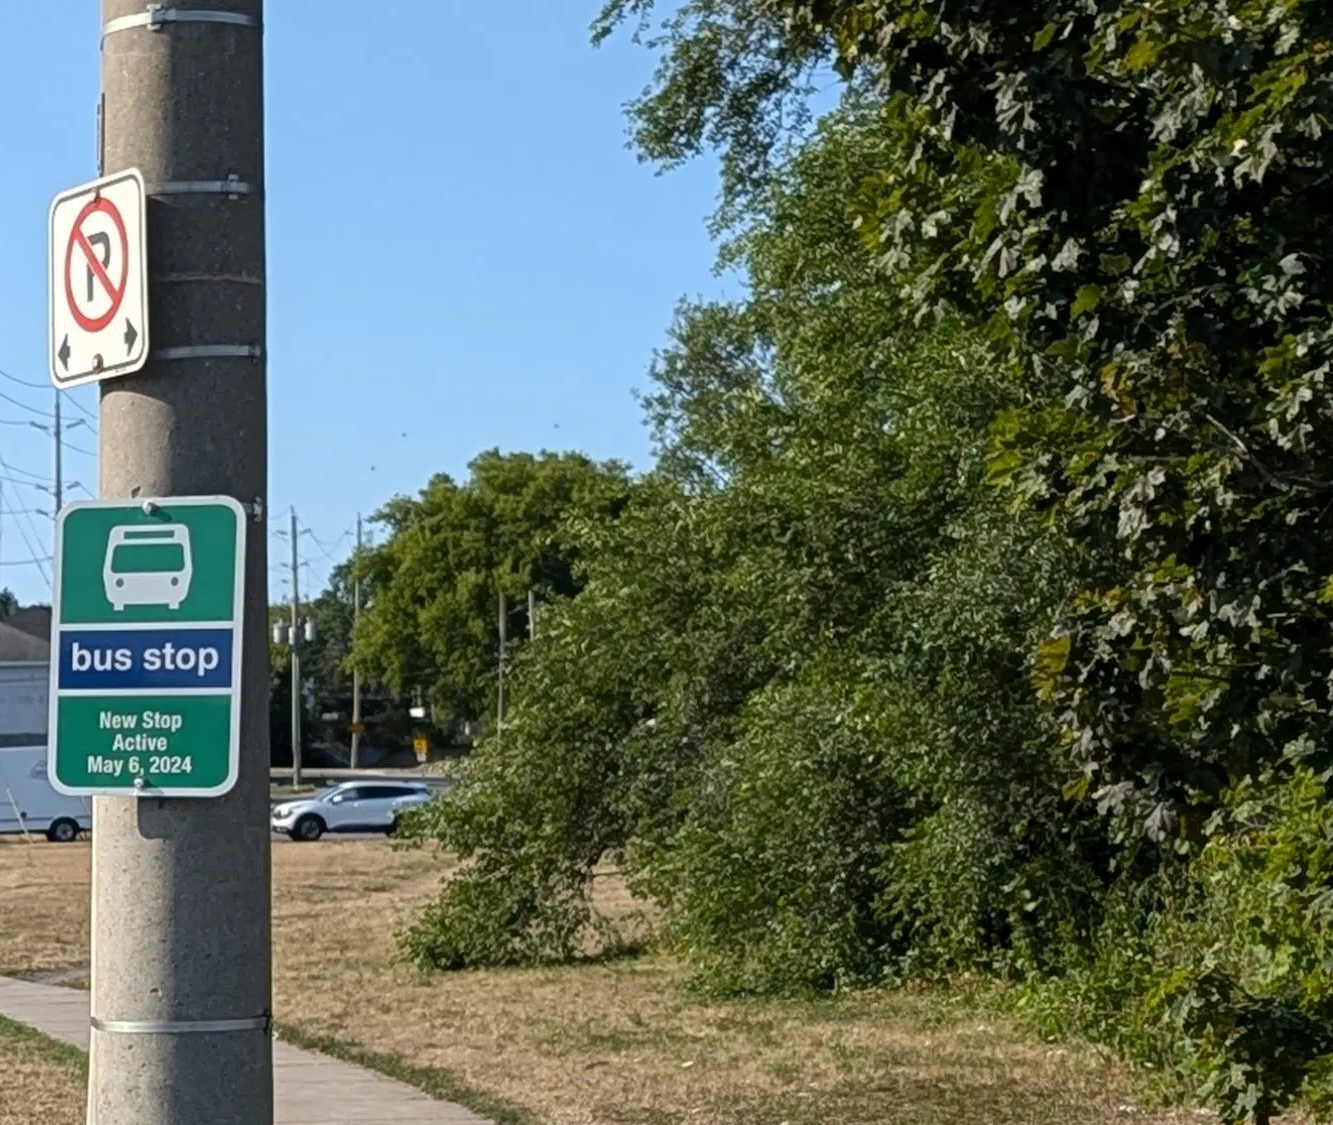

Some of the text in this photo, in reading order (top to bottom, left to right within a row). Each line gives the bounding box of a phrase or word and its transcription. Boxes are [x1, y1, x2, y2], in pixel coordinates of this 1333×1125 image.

[72, 642, 219, 676] bus stop
[99, 710, 183, 732] New Stop
[112, 733, 168, 751] Active
[87, 756, 192, 777] May 6, 2024
